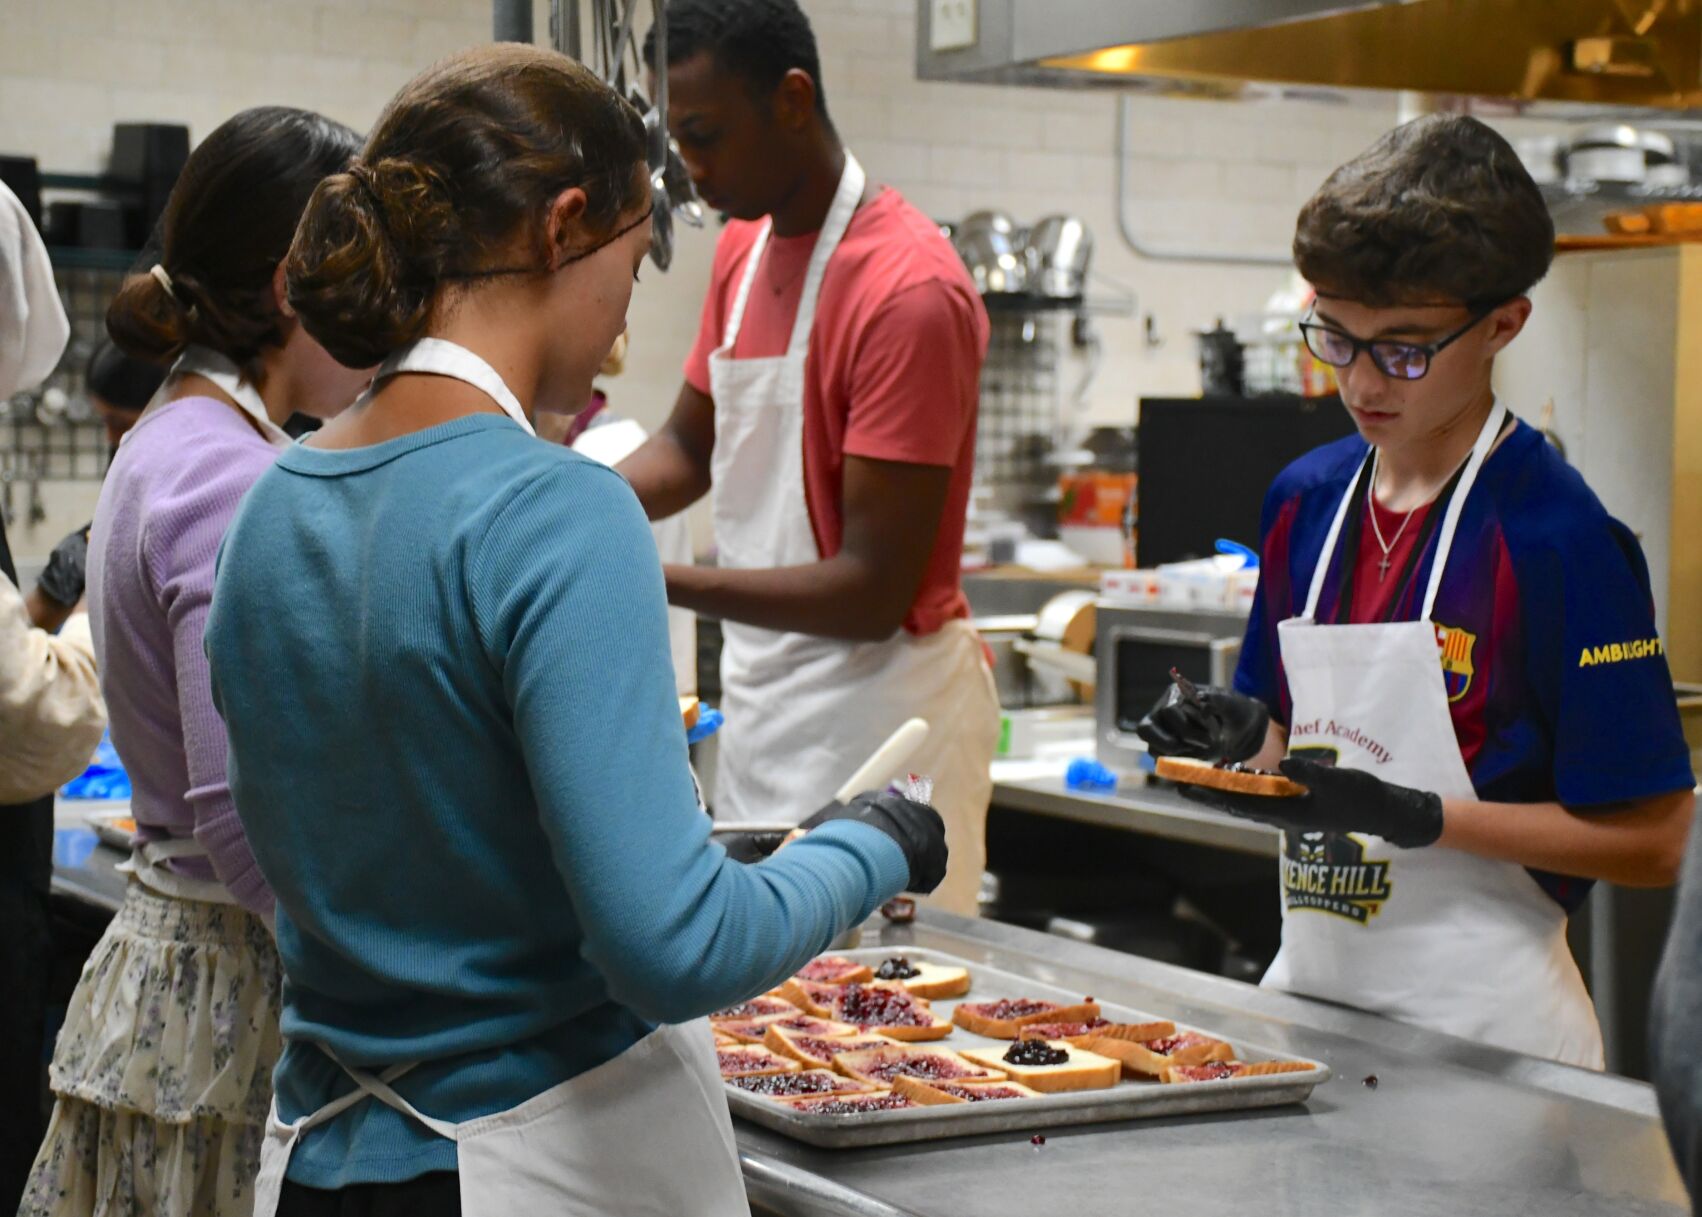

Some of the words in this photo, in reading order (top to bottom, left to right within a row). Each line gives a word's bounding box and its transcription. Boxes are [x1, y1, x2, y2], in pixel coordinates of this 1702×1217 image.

[1324, 719, 1393, 764] Academy
[1285, 860, 1329, 895] ENCE
[1330, 865, 1385, 896] HILL
